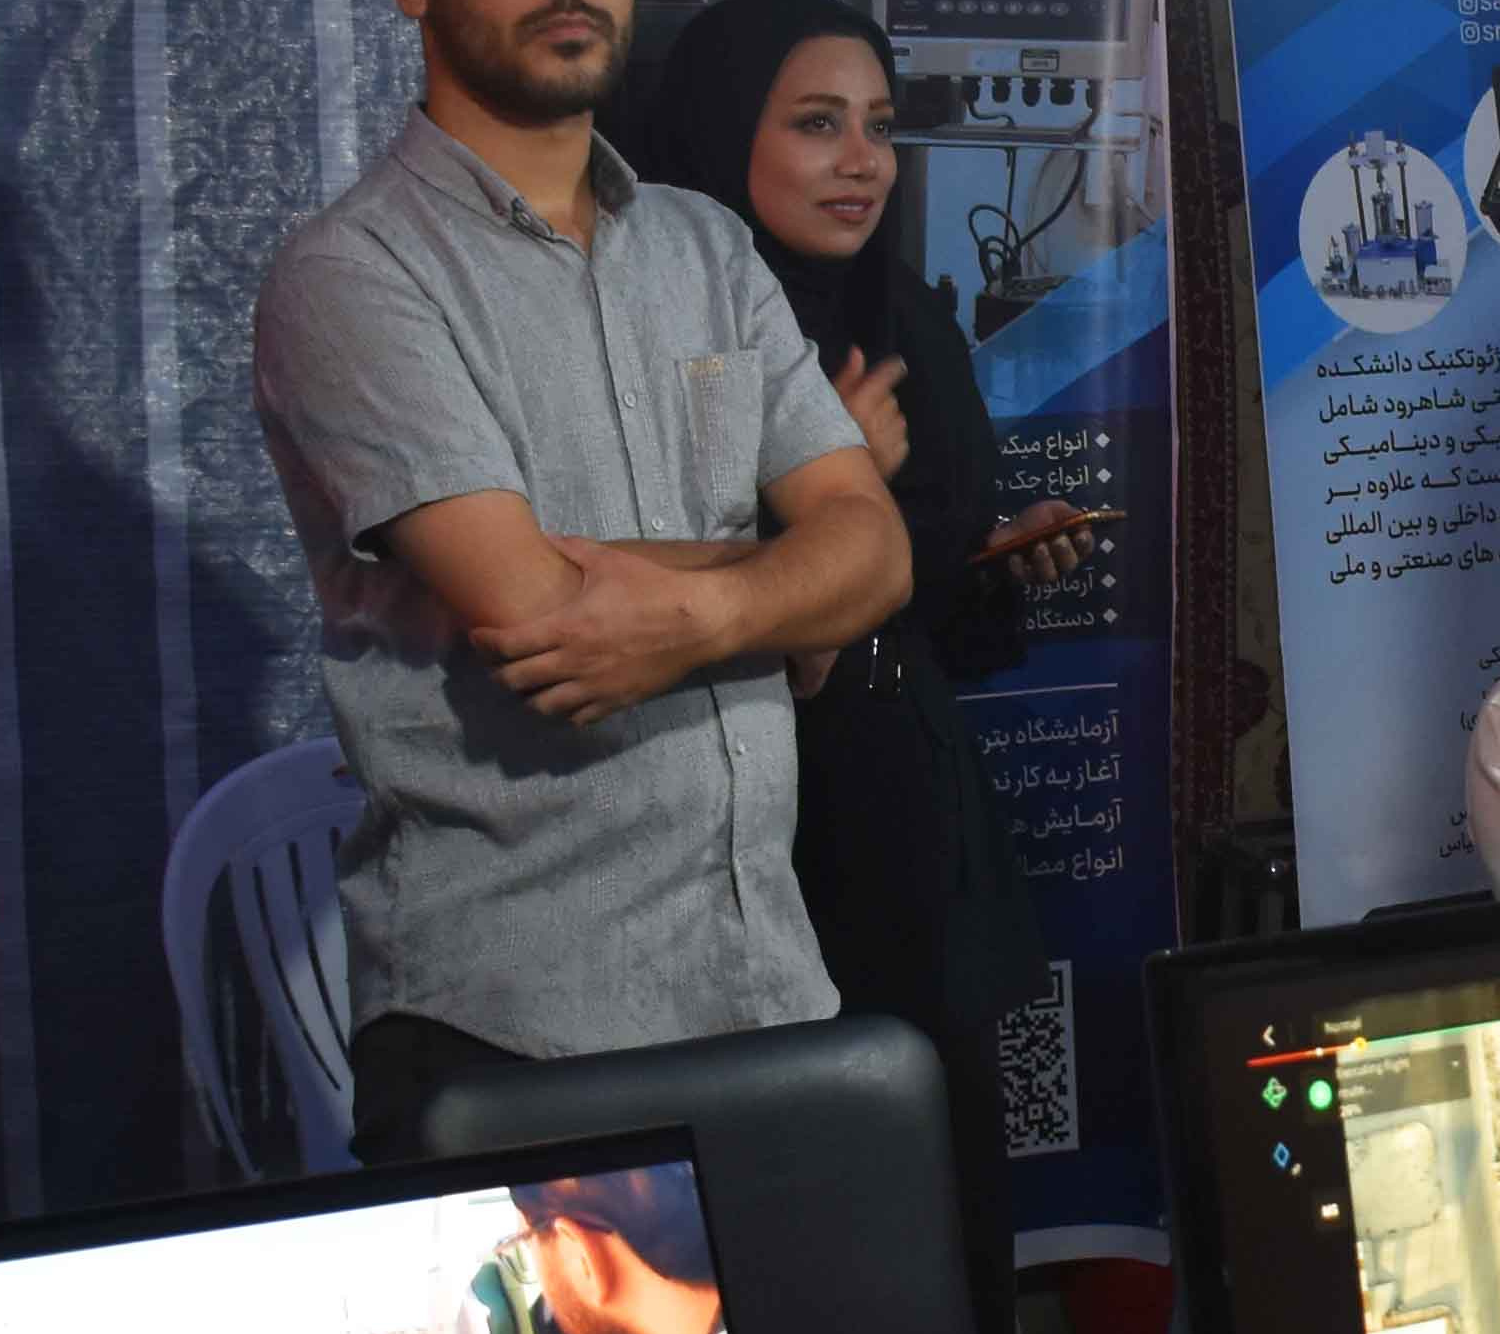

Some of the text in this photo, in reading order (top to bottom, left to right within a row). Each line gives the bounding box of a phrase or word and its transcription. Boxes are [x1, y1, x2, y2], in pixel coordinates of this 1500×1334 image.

[1316, 350, 1413, 379] دانشکده
[1318, 393, 1379, 424] شامل
[1384, 386, 1466, 419] شاهرود
[1045, 428, 1088, 460] انواع
[1323, 428, 1442, 465] دینامیکی
[1445, 434, 1457, 455] و
[1046, 464, 1091, 495] انواع
[1324, 480, 1362, 505] بر
[1367, 467, 1417, 500] علاوه
[1420, 465, 1462, 489] که
[1325, 510, 1383, 545] المللی
[1387, 515, 1423, 540] بین
[1426, 515, 1438, 536] و
[1442, 501, 1497, 534] داخلی
[1329, 553, 1367, 585] ملی
[1371, 559, 1383, 580] و
[1385, 550, 1454, 578] صنعتی
[1457, 539, 1495, 571] های
[1025, 610, 1095, 632] دستگاه
[1014, 708, 1121, 746] آزمایشگاه
[1044, 767, 1072, 794] به
[1074, 753, 1122, 793] آغاز
[1031, 797, 1124, 839] آزمایش
[1071, 843, 1125, 881] انواع
